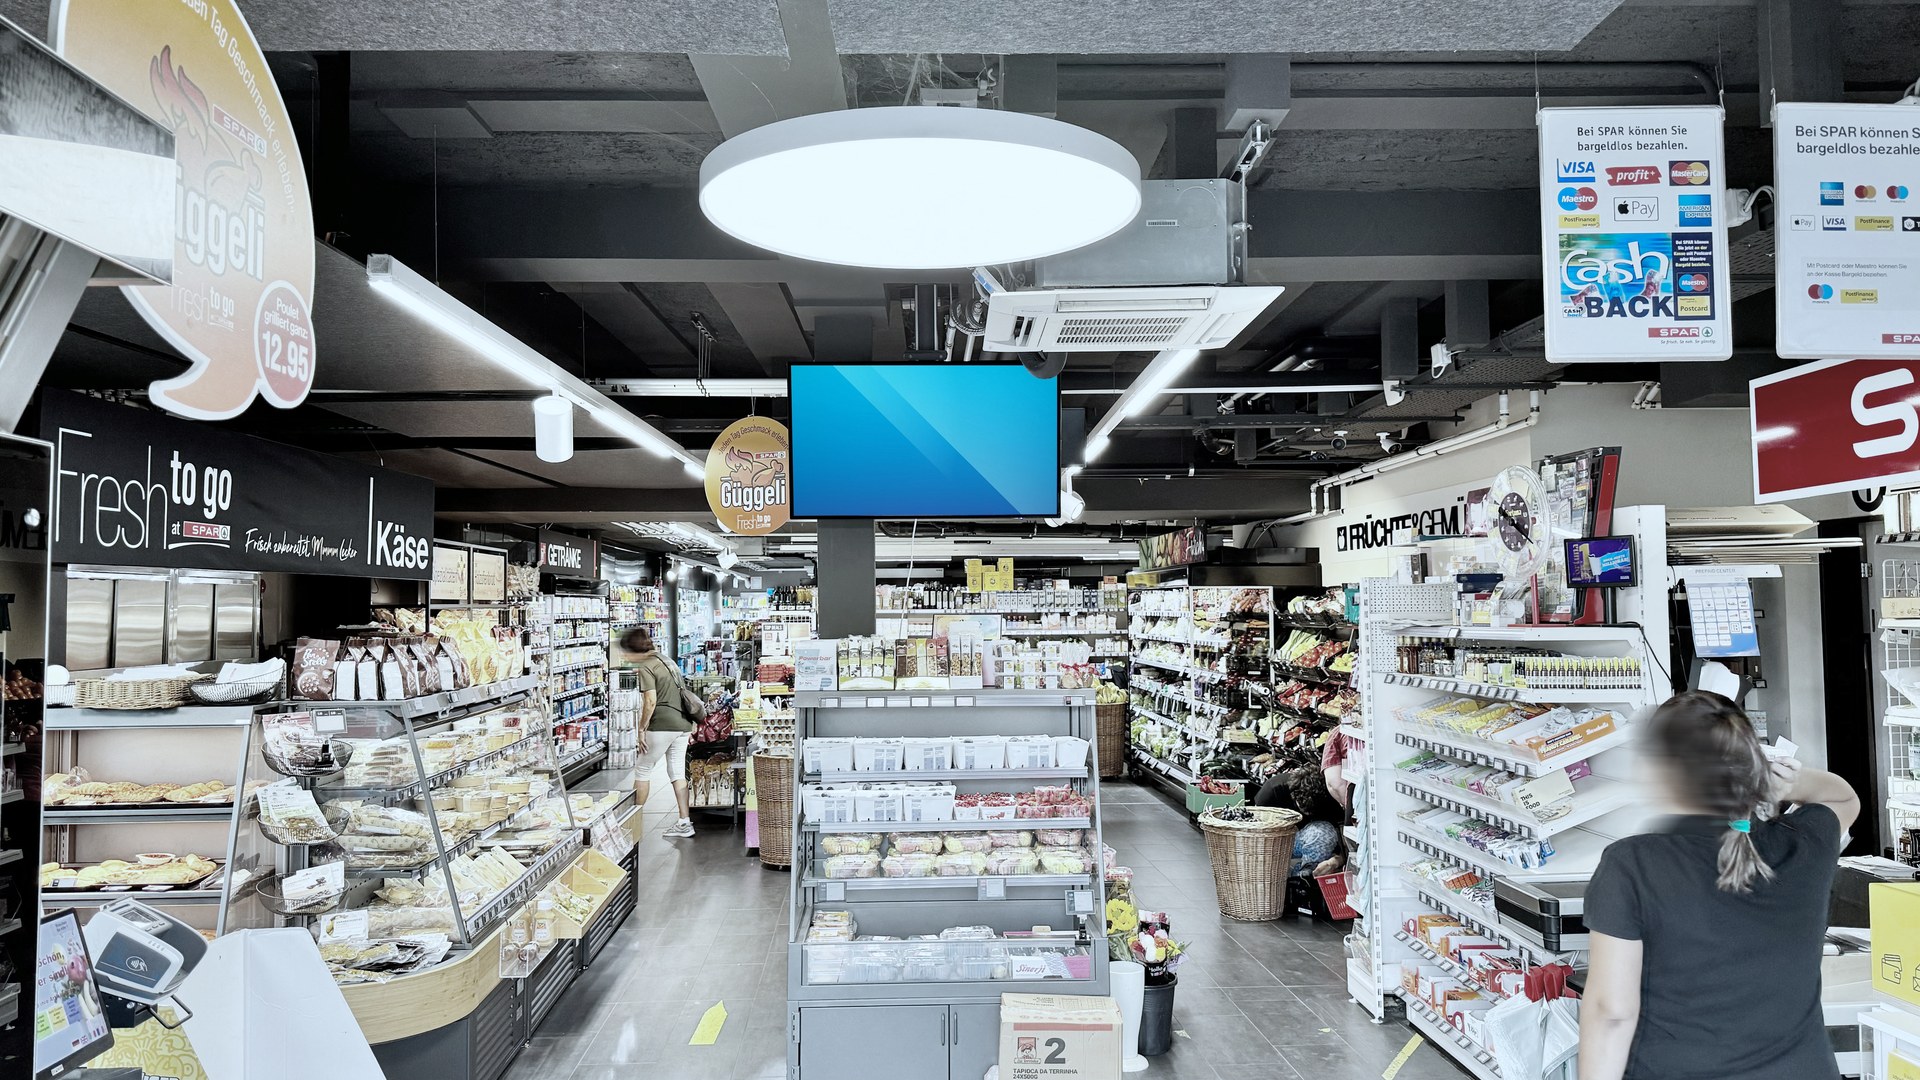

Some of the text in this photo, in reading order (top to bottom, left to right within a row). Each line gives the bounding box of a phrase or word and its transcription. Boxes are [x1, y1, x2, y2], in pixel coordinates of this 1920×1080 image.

[211, 6, 229, 48] Tag
[227, 37, 276, 138] Geschmack
[223, 115, 257, 150] SPAR
[1577, 125, 1688, 136] Bei SPAR können Sie
[1795, 125, 1817, 137] Bei
[1820, 126, 1857, 138] SPAR
[1860, 126, 1909, 139] können
[1577, 140, 1688, 153] bargeldlos bezahlen.
[1796, 142, 1920, 156] bargeldlos bezahle
[1562, 161, 1595, 173] VISA
[1671, 169, 1707, 177] MasterCard
[1561, 195, 1594, 203] Maestro
[1631, 200, 1656, 217] Pay
[176, 160, 265, 282] ggeli
[1800, 218, 1813, 227] Pay
[1825, 217, 1846, 226] VISA
[1561, 240, 1670, 290] Cash
[210, 286, 234, 318] to go
[276, 297, 299, 320] Poulet
[1584, 295, 1674, 318] BACK
[264, 311, 290, 332] grilliert
[1659, 328, 1699, 337] SPAR
[1893, 335, 1920, 343] SPA
[262, 331, 309, 382] 12.95
[1850, 367, 1919, 459] S
[55, 427, 168, 550] Fresh
[170, 450, 233, 519] to go
[720, 479, 787, 512] Güggeli
[171, 521, 220, 538] at SPAR
[736, 514, 757, 530] Fresh
[375, 520, 429, 570] Käse
[547, 542, 582, 569] GETRÄNKE
[1043, 1037, 1066, 1065] 2
